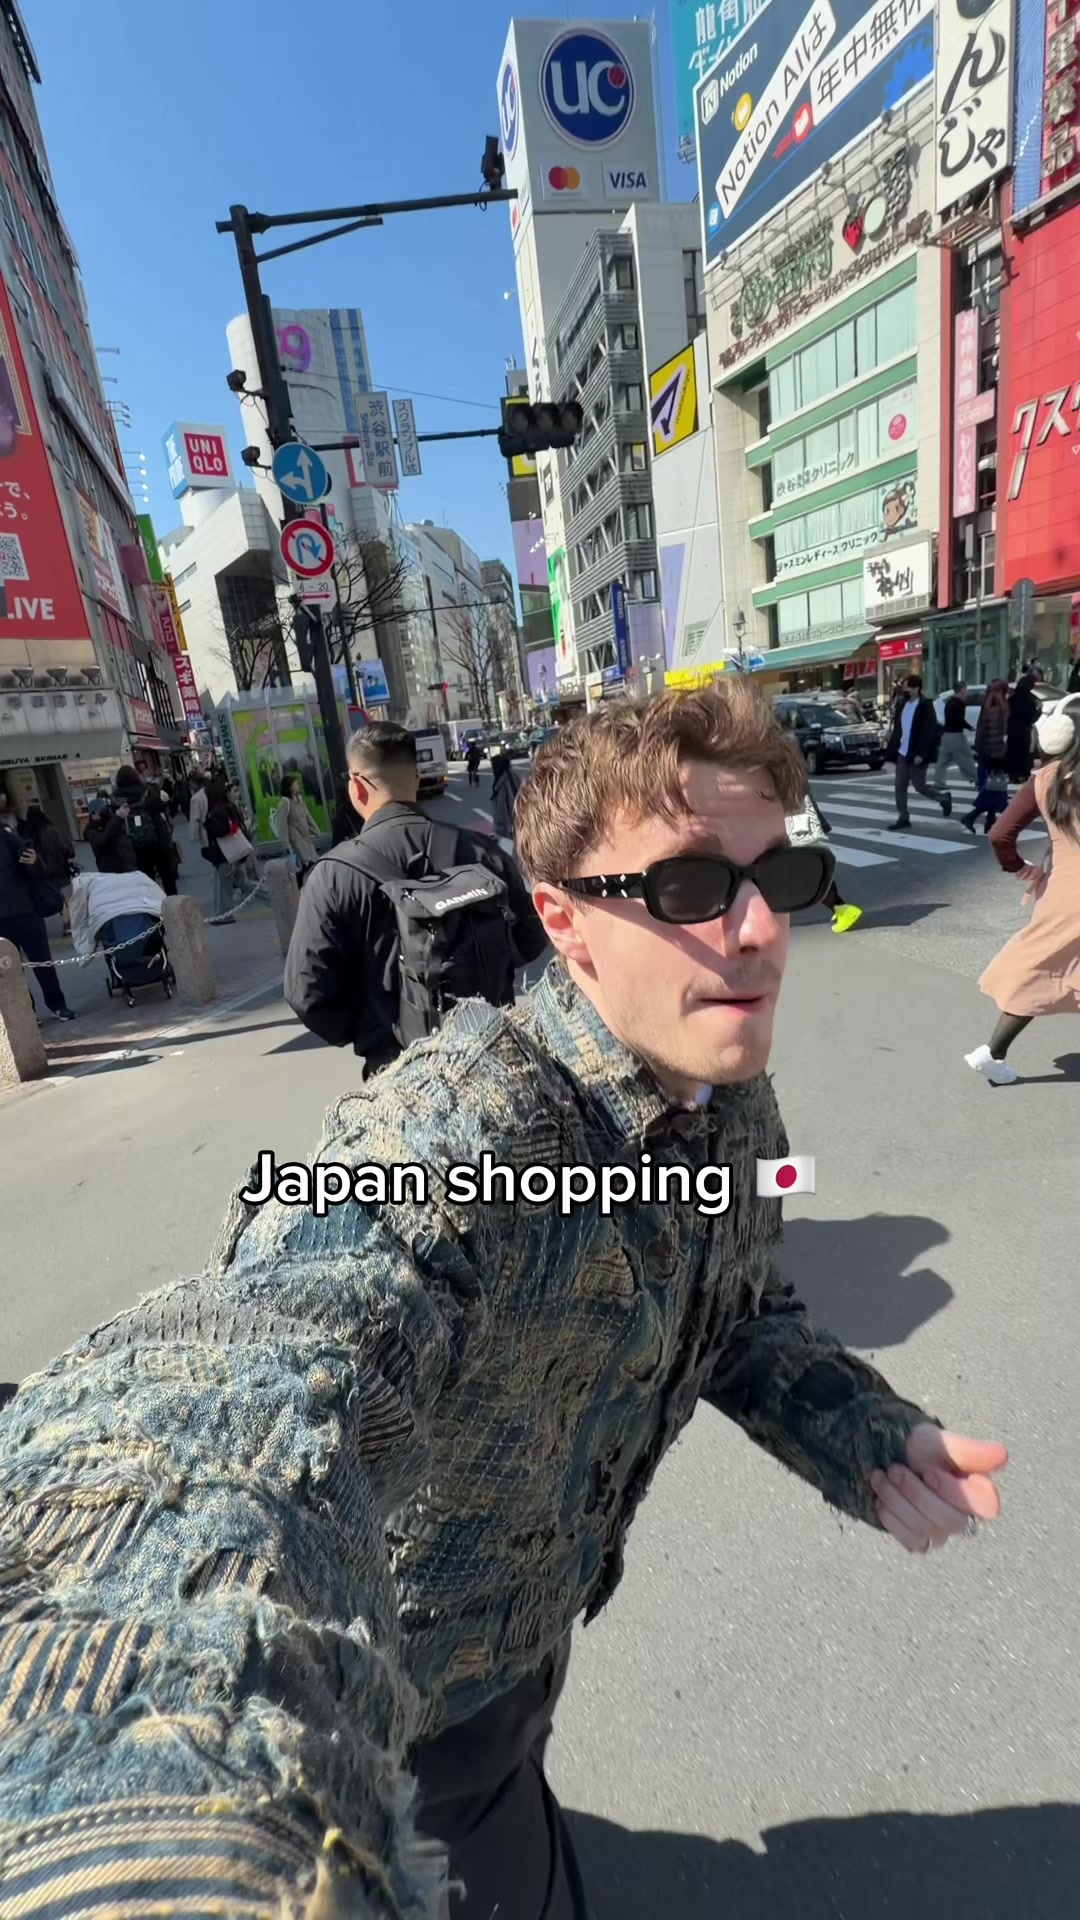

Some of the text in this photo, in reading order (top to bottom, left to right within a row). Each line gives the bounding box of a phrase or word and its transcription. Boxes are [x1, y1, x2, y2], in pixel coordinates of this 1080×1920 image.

[720, 42, 758, 98] Notion
[939, 0, 1006, 177] んじゃ
[609, 171, 647, 189] VISA
[721, 102, 780, 204] Notion
[188, 438, 218, 455] UNI
[192, 455, 223, 473] QLO
[369, 400, 394, 478] 渋谷駅前
[1007, 381, 1080, 502] クス
[8, 597, 55, 620] IVE
[175, 657, 200, 712] スギ薬局
[435, 888, 488, 910] GARMIN
